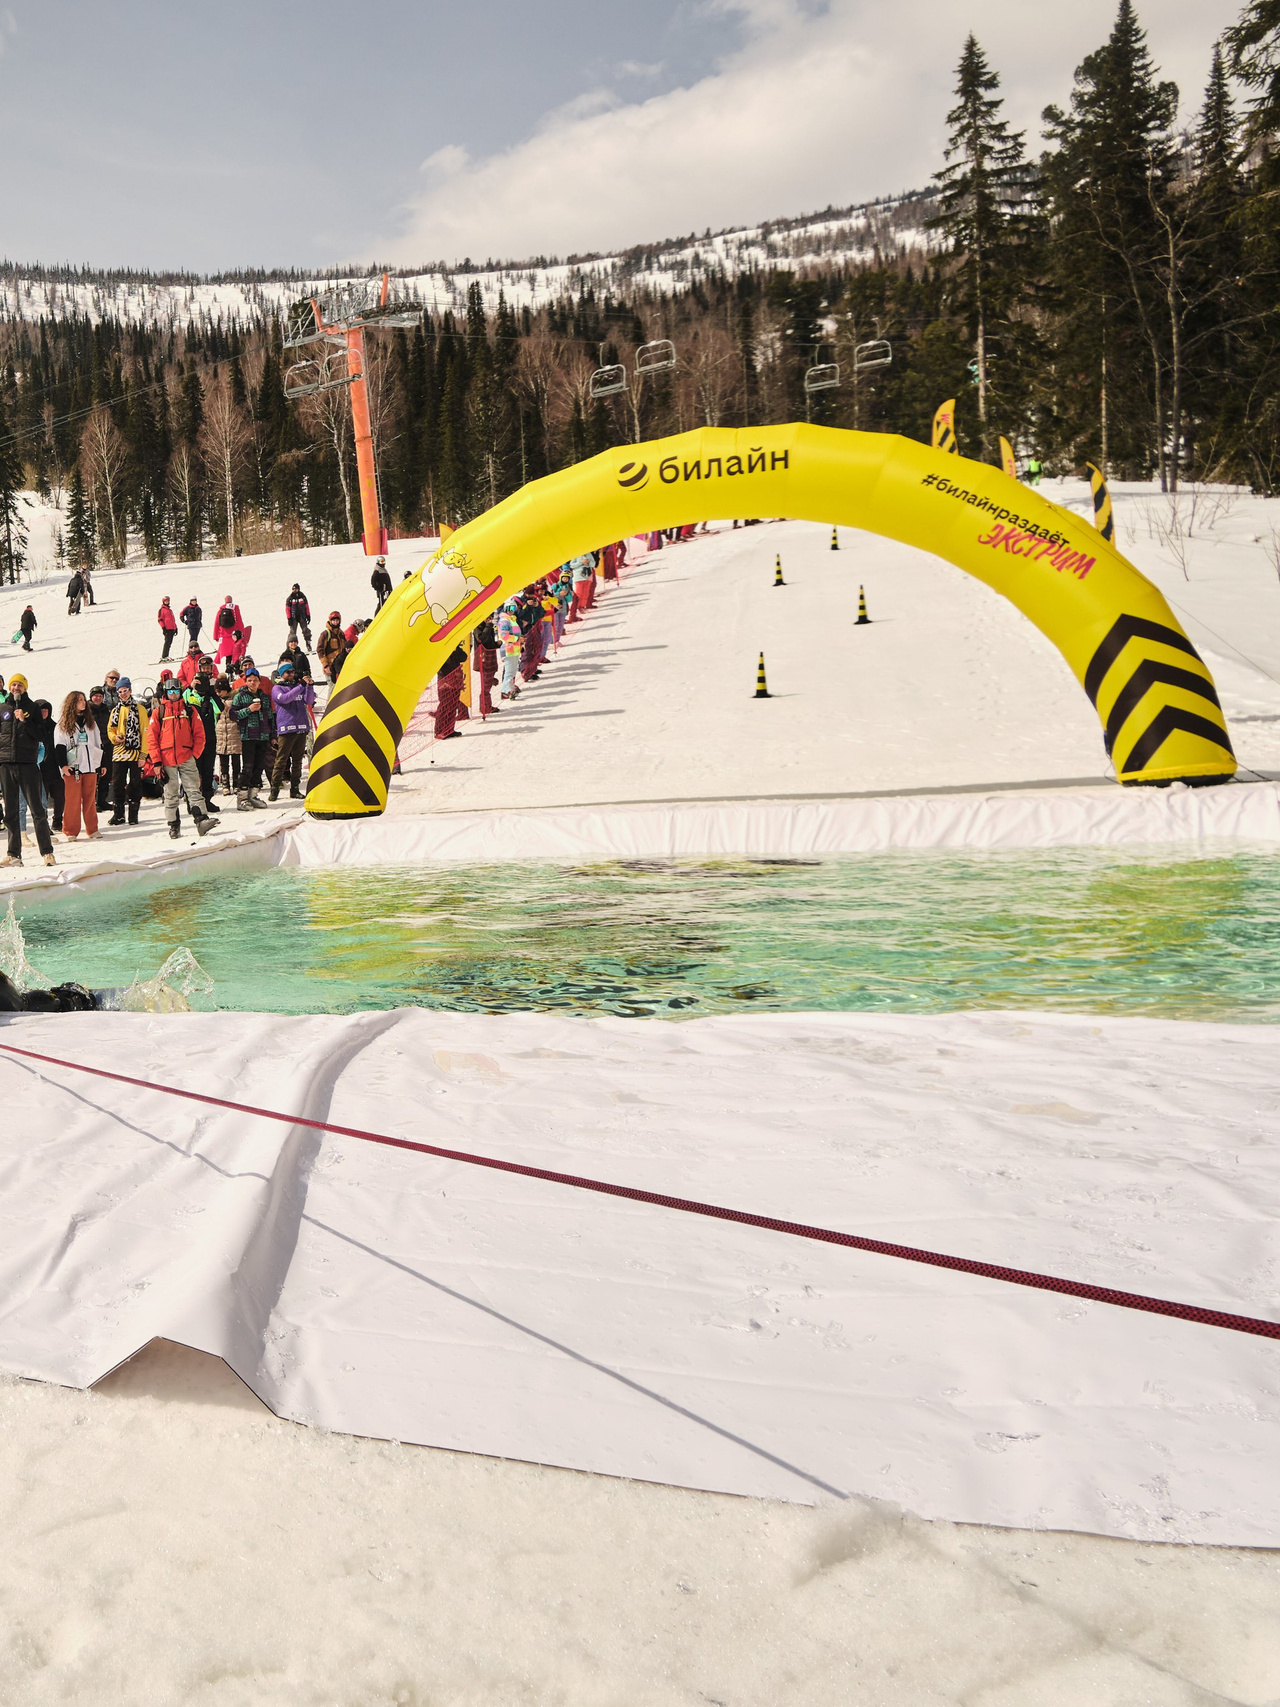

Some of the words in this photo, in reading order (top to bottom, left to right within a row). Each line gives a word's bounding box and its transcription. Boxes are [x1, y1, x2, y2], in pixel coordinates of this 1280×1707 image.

[659, 446, 790, 484] билайн
[921, 473, 1070, 548] #билайнраздаёт
[977, 523, 1097, 581] ЭКСТРИМ
